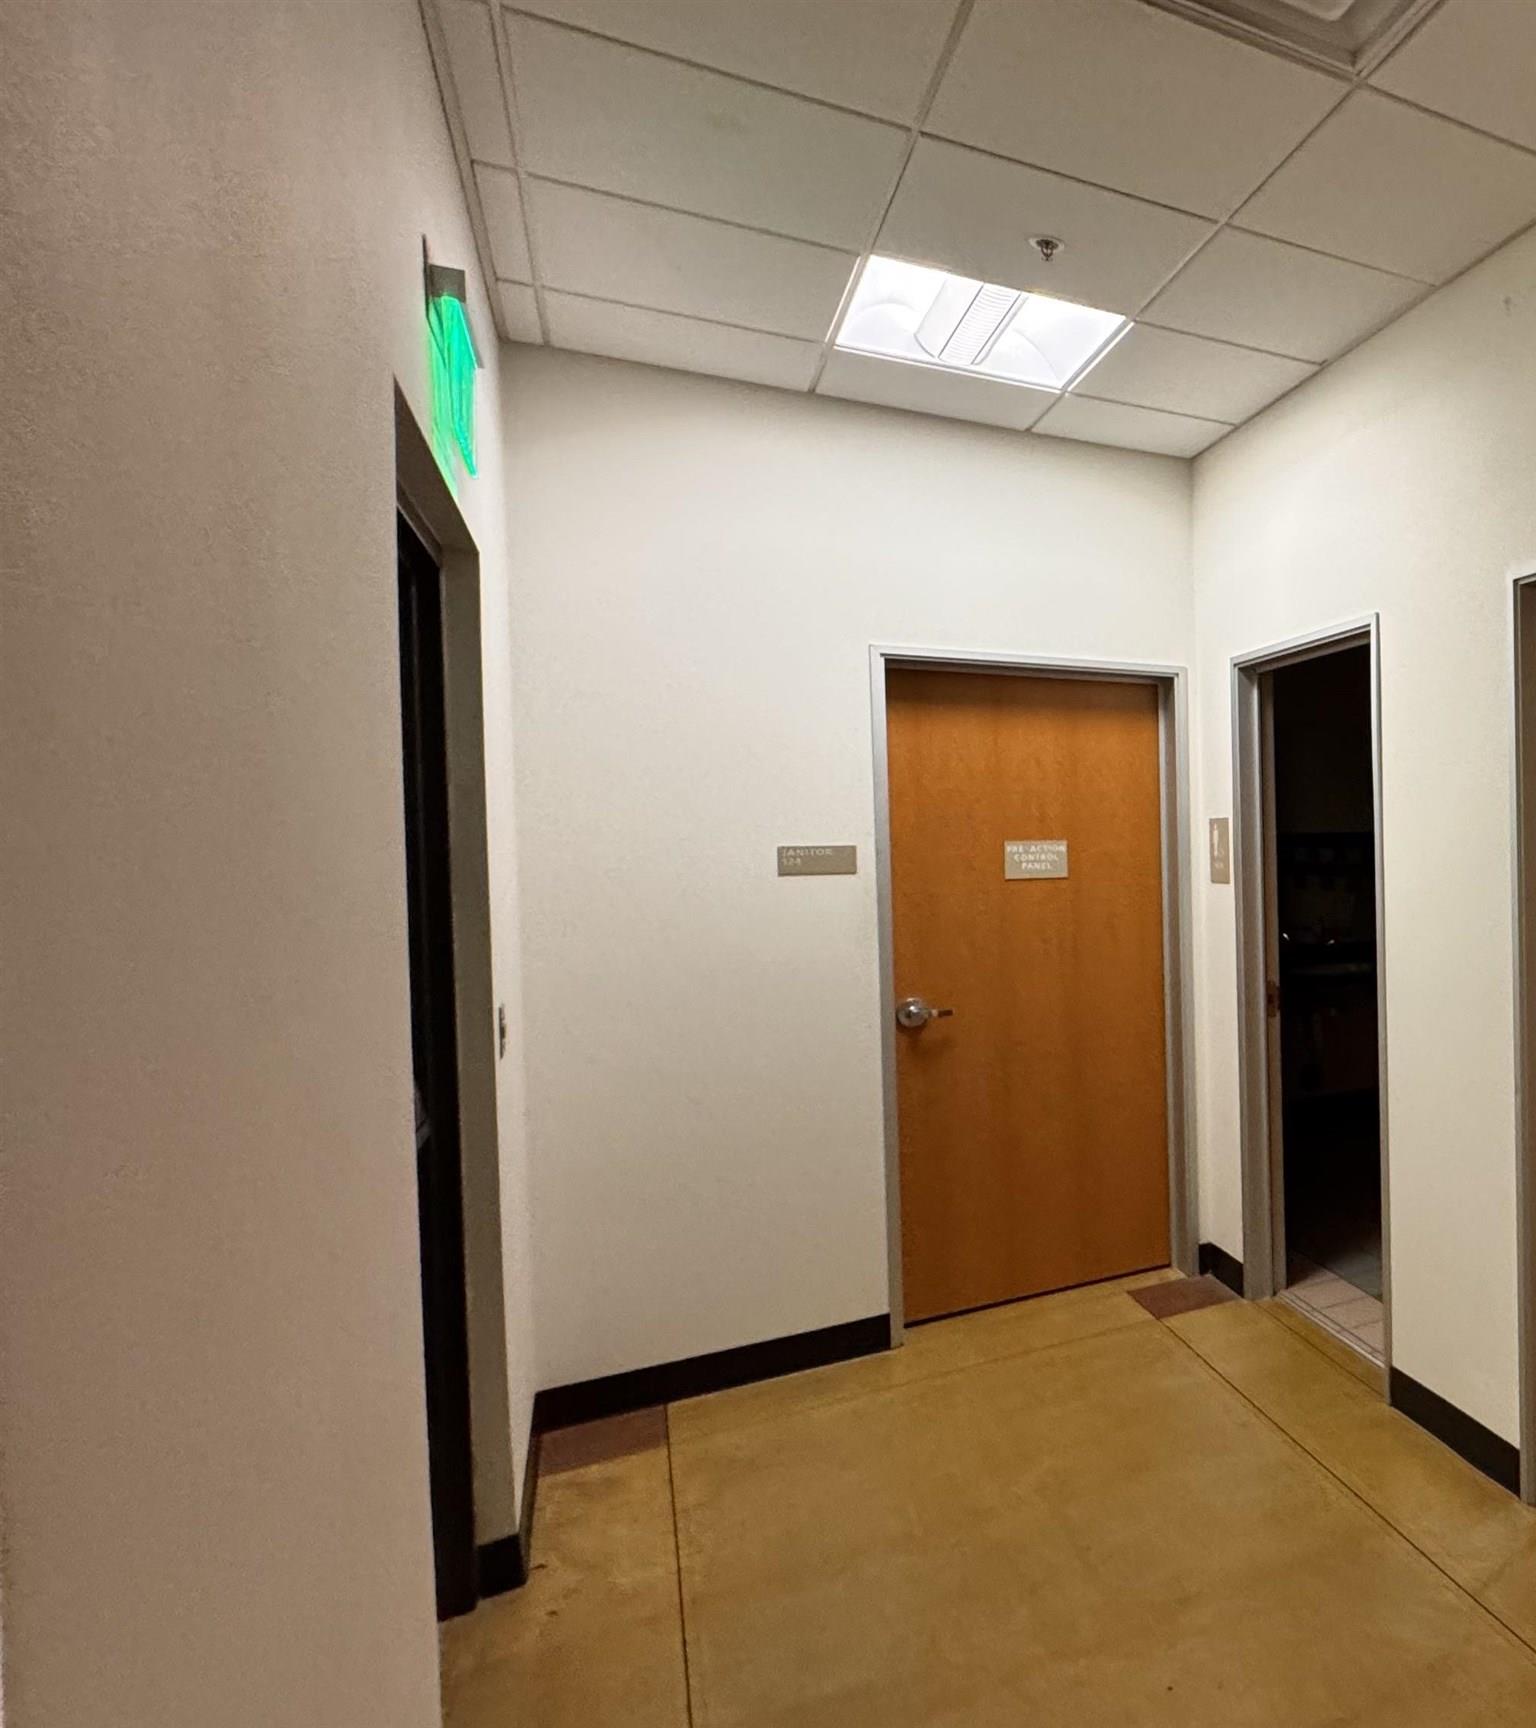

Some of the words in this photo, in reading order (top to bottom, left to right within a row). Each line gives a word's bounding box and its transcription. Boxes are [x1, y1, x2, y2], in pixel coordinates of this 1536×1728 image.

[782, 847, 833, 856] JANITOR
[1013, 853, 1059, 862] CONTROL
[1021, 862, 1051, 870] PANEL
